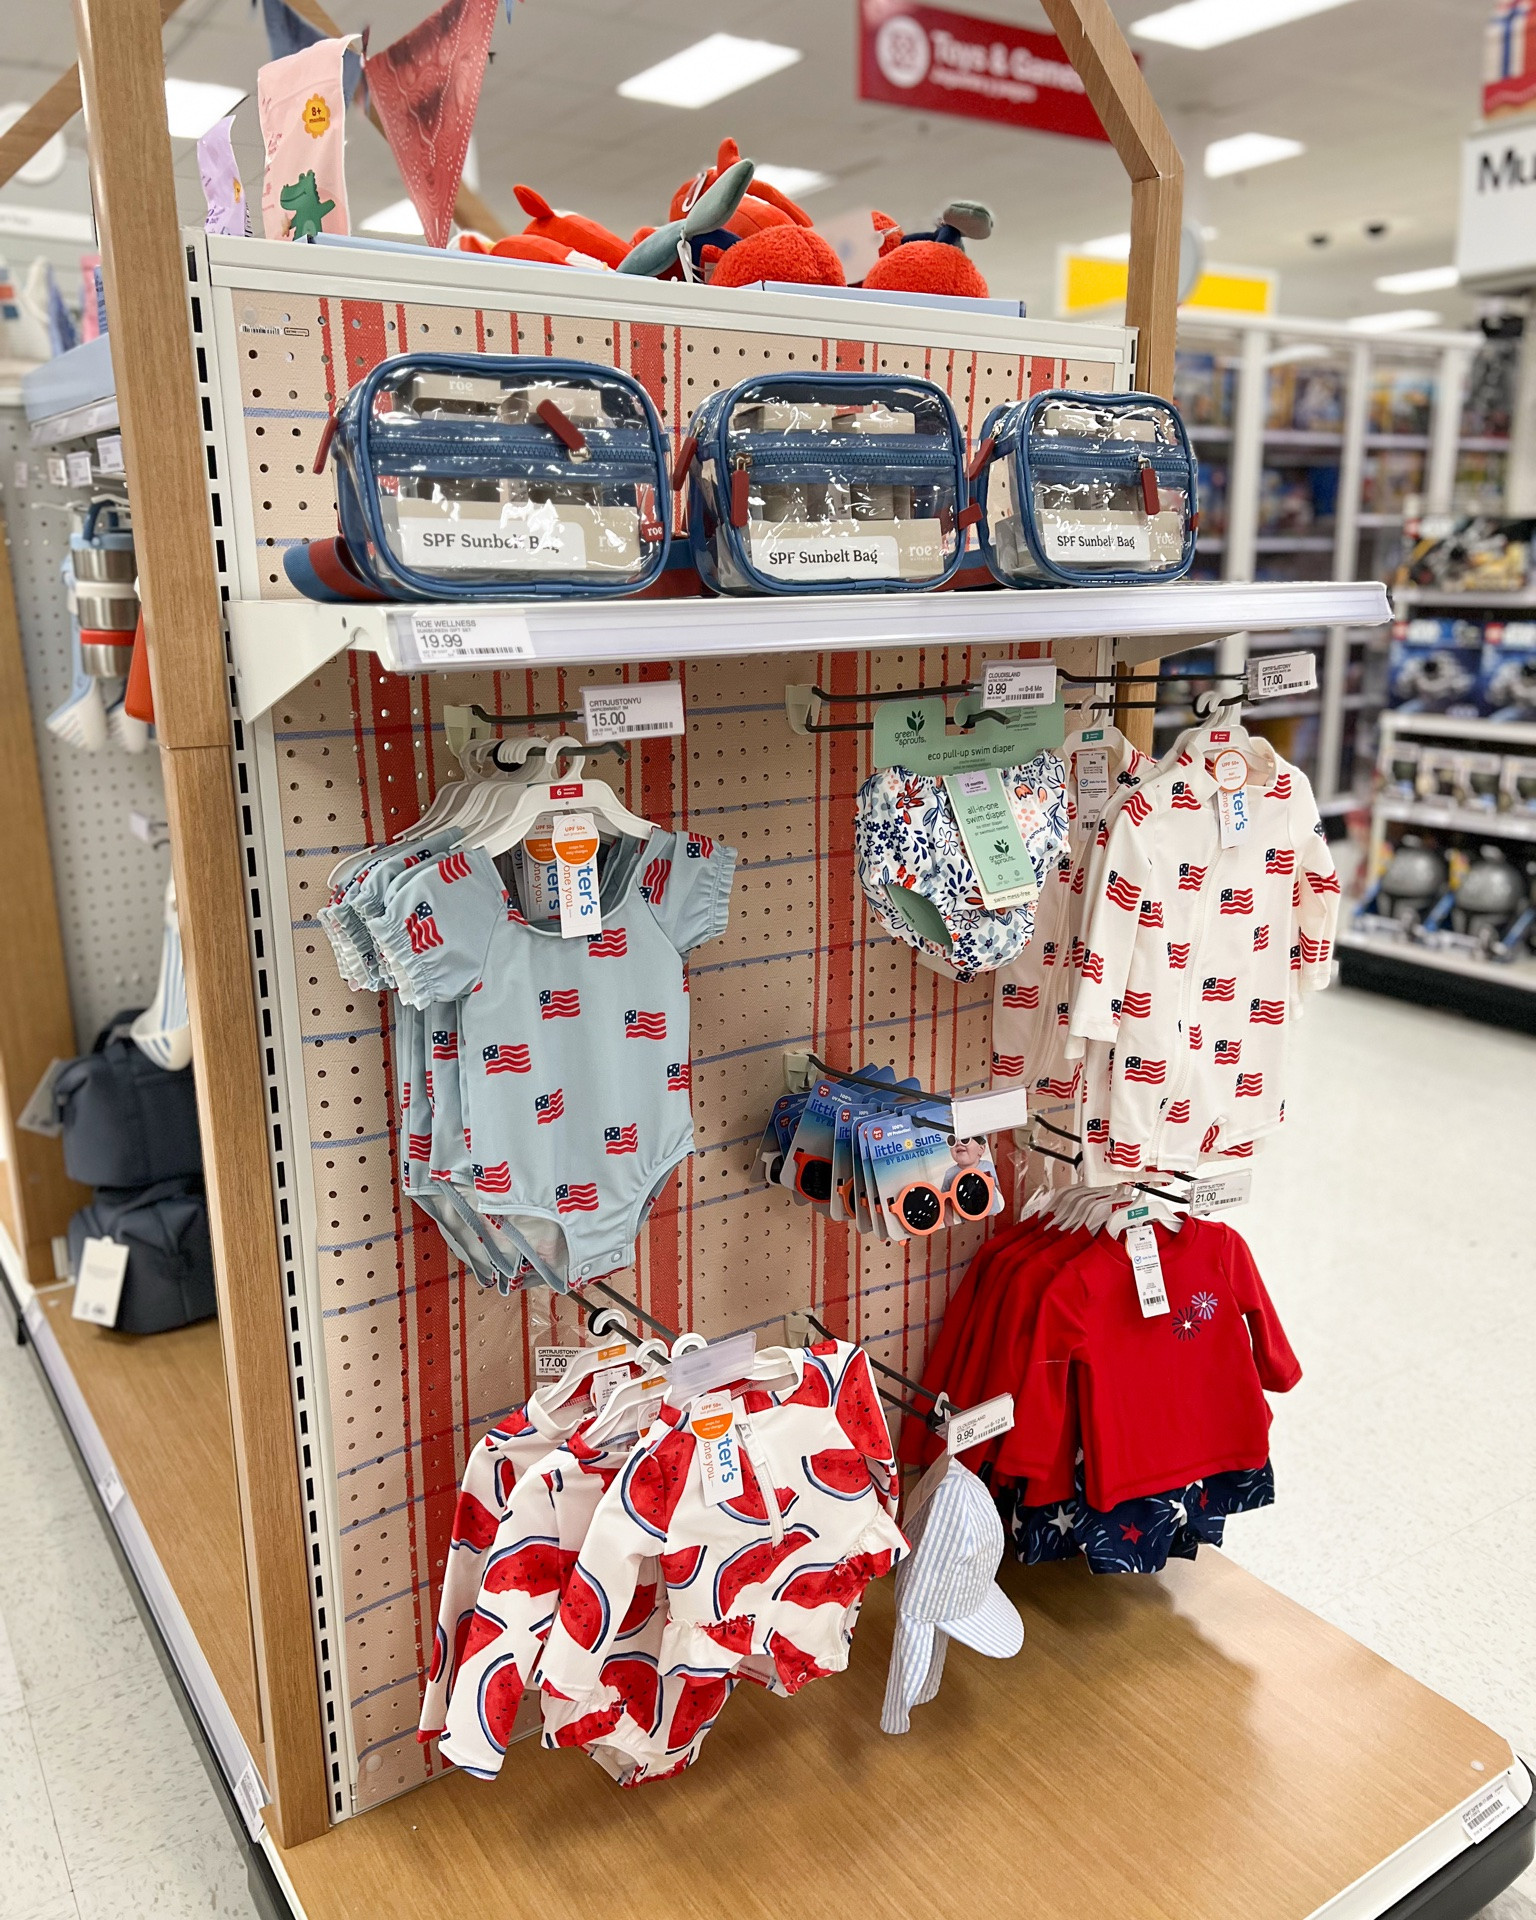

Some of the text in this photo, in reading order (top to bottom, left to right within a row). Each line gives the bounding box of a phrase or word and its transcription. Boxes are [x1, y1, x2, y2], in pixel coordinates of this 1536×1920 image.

[930, 29, 988, 72] Toys
[311, 107, 322, 117] 8+
[449, 379, 474, 391] roe
[647, 527, 663, 537] roe
[422, 532, 456, 548] SPF
[1057, 535, 1076, 547] SPF
[1117, 536, 1135, 549] Bag
[769, 549, 878, 565] SPF Sunbelt Bag
[909, 544, 933, 557] roe
[415, 619, 477, 628] ROE WELLNESS
[420, 634, 463, 649] 19.99
[988, 671, 1021, 679] CLOUDISLAND
[1262, 674, 1283, 687] 17.00
[987, 683, 1007, 695] 9.99
[592, 711, 626, 727] 15.00
[895, 730, 915, 743] green
[899, 735, 926, 748] sprouts
[928, 744, 1016, 761] eco pull-up swim diaper
[556, 788, 562, 796] 6
[967, 801, 999, 814] all-in-one
[1232, 790, 1248, 831] ter's
[966, 810, 1007, 825] swim diaper
[989, 853, 1004, 864] green
[994, 856, 1015, 867] sprouts
[534, 862, 542, 882] one
[563, 865, 572, 885] one
[577, 861, 598, 916] ter's
[994, 895, 1007, 903] swim
[840, 1093, 852, 1102] 100%
[810, 1098, 837, 1119] little
[839, 1126, 851, 1138] lit
[874, 1133, 942, 1158] little suns
[896, 1148, 934, 1163] BABIATORS
[1195, 1192, 1217, 1203] 21.00
[539, 1358, 568, 1368] 17.00
[956, 1428, 974, 1443] 9.99
[703, 1441, 712, 1460] one
[717, 1433, 738, 1483] ter's
